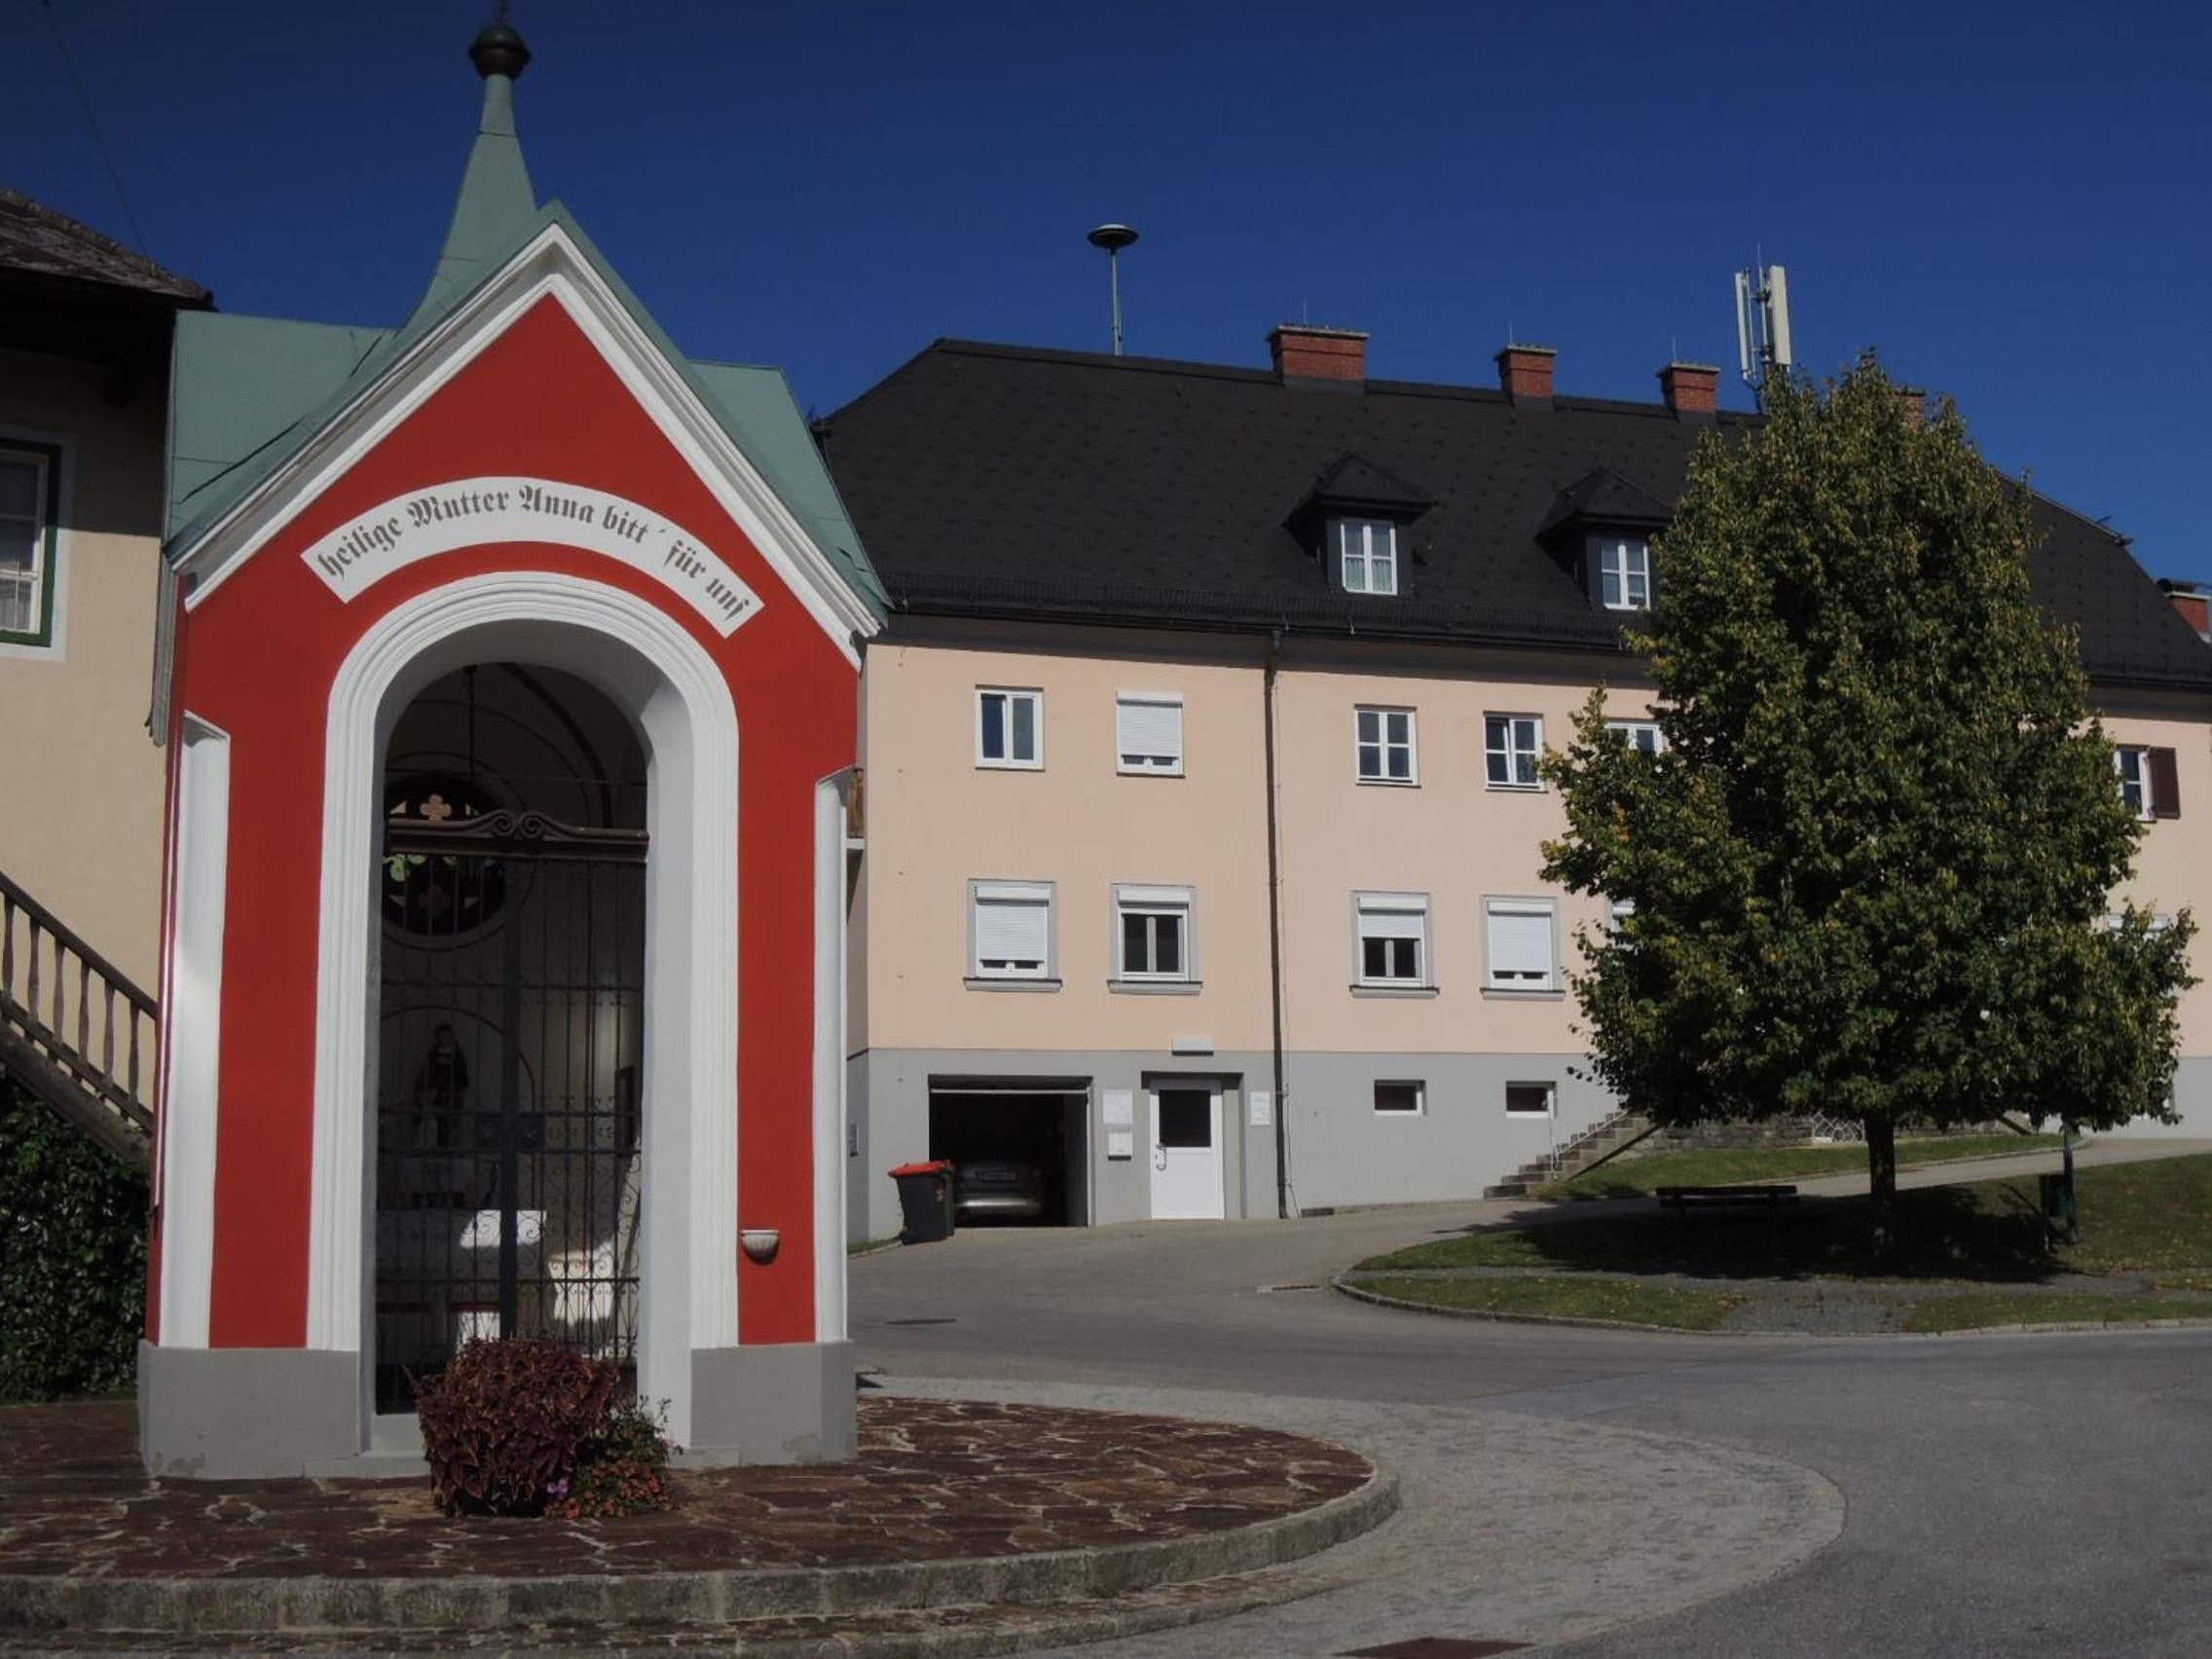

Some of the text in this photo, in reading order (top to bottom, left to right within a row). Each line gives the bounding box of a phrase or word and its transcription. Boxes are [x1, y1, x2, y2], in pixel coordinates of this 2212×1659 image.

[317, 517, 402, 580] heilige
[406, 491, 510, 528] Mutter
[518, 485, 595, 524] Anna
[663, 539, 707, 579] für
